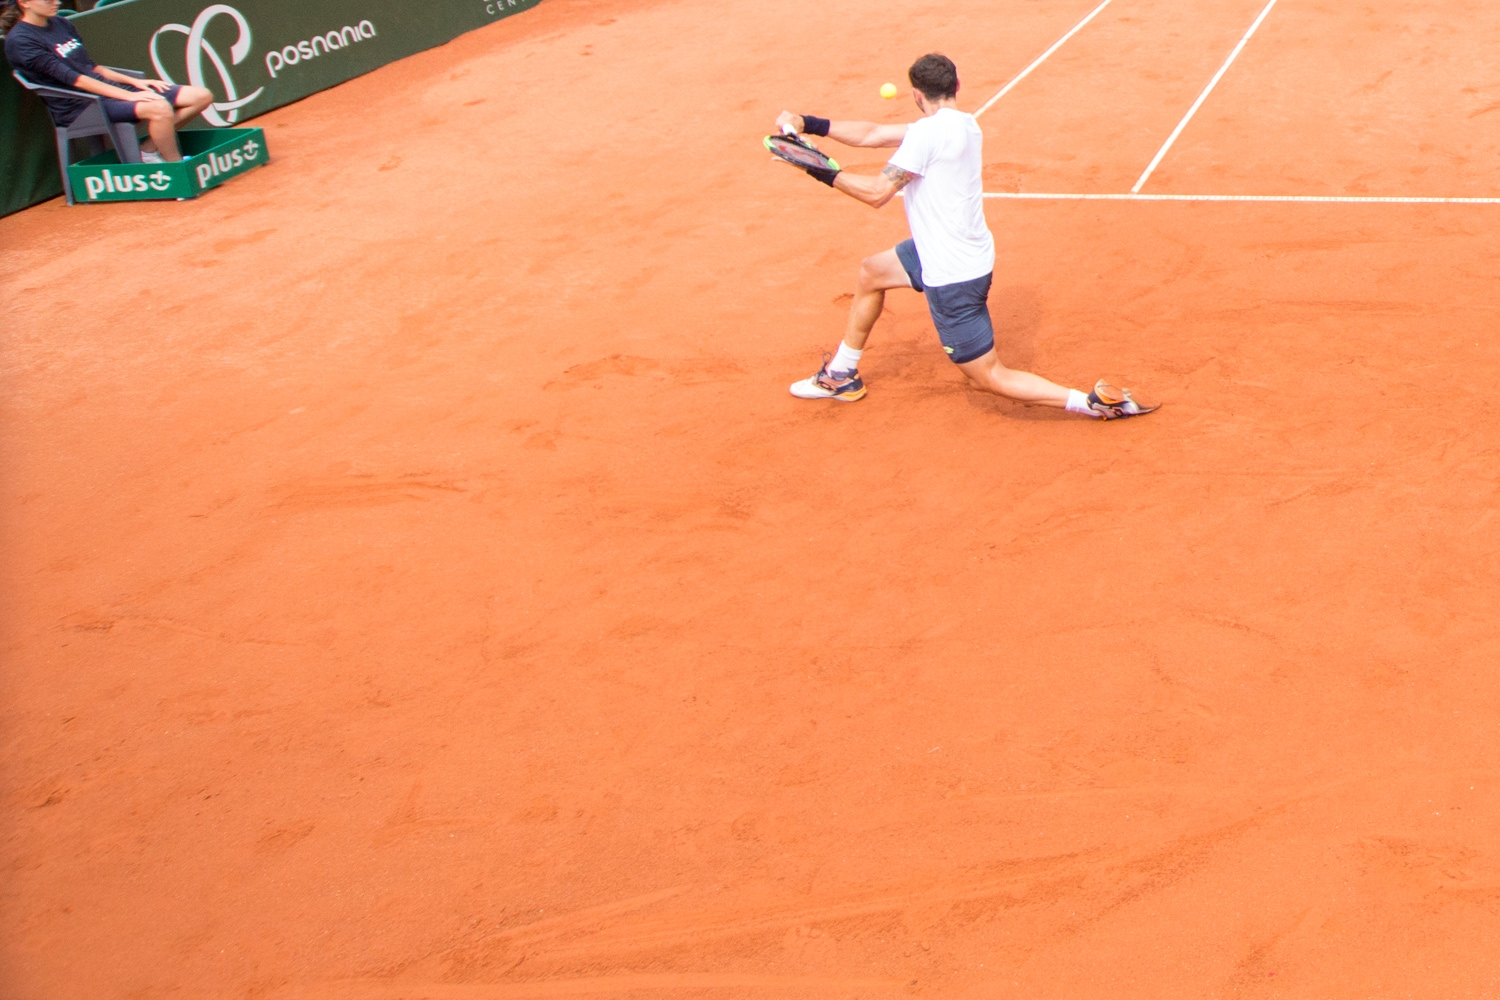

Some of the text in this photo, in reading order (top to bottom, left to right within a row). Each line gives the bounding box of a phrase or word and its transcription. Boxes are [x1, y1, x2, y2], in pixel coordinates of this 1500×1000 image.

[265, 19, 377, 78] posnania
[85, 169, 148, 199] plus
[197, 150, 243, 189] plus
